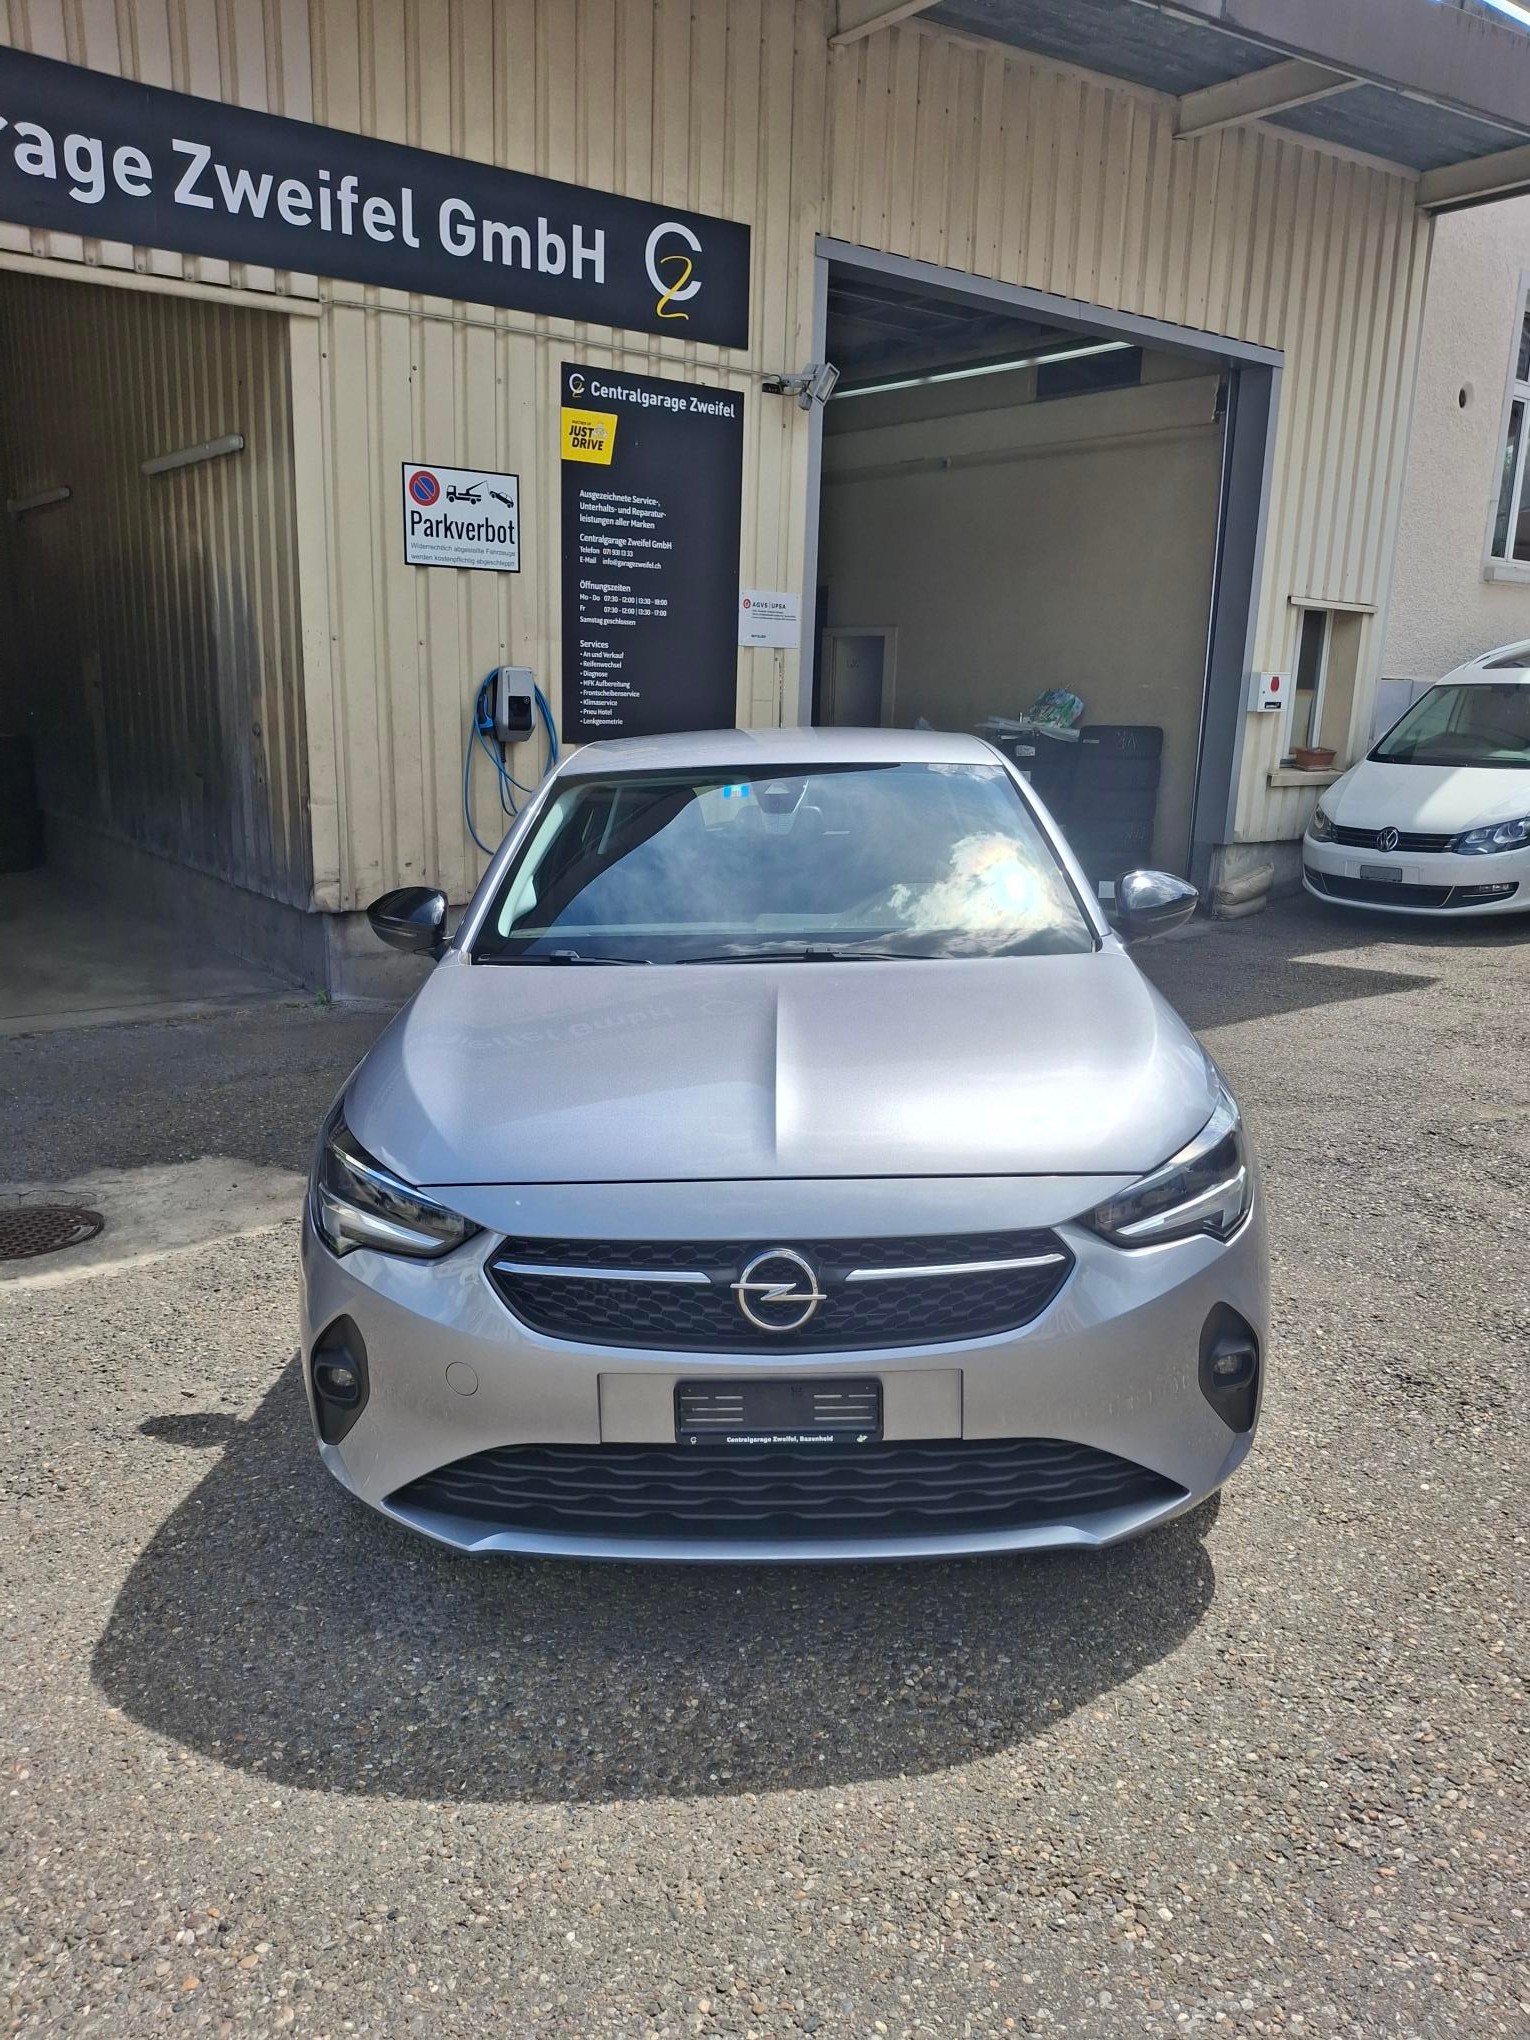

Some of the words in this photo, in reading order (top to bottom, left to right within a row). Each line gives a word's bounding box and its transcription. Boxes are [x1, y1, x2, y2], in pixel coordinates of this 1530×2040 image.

[172, 138, 420, 249] Zweifel
[439, 198, 605, 284] GmbH
[591, 381, 687, 412] Centralgarage
[689, 397, 736, 418] Zweifel
[569, 425, 595, 438] JUST
[572, 437, 604, 451] DRIVE
[580, 489, 632, 502] Ausgezeichnete
[580, 502, 617, 513] Unterhalts-
[618, 506, 631, 515] und
[632, 507, 667, 519] Reparatur-
[580, 513, 614, 526] leistungen
[615, 518, 630, 527] aller
[631, 520, 656, 529] Marken
[410, 509, 516, 545] Parkverbot
[580, 533, 627, 547] Centralgarage
[627, 537, 651, 548] Zweifel
[652, 540, 672, 550] GmbH
[580, 546, 600, 554] Telefon
[580, 556, 597, 564] E-Mail
[580, 580, 631, 593] Öffnungszeiten
[580, 604, 586, 612] Fr
[580, 616, 603, 625] Samstag
[604, 617, 636, 626] geschlossen
[580, 640, 609, 649] Services
[603, 651, 624, 659] Verkauf
[583, 660, 622, 669] Reifenwechsel
[583, 670, 608, 679] Diagnose
[596, 680, 631, 690] Aufbereitung
[583, 689, 640, 698] Frontscheibenservice
[598, 708, 612, 716] Hotel
[583, 718, 623, 727] Lenkgeometrie
[726, 1436, 771, 1444] Centralgarage
[772, 1435, 799, 1444] Zweifel,
